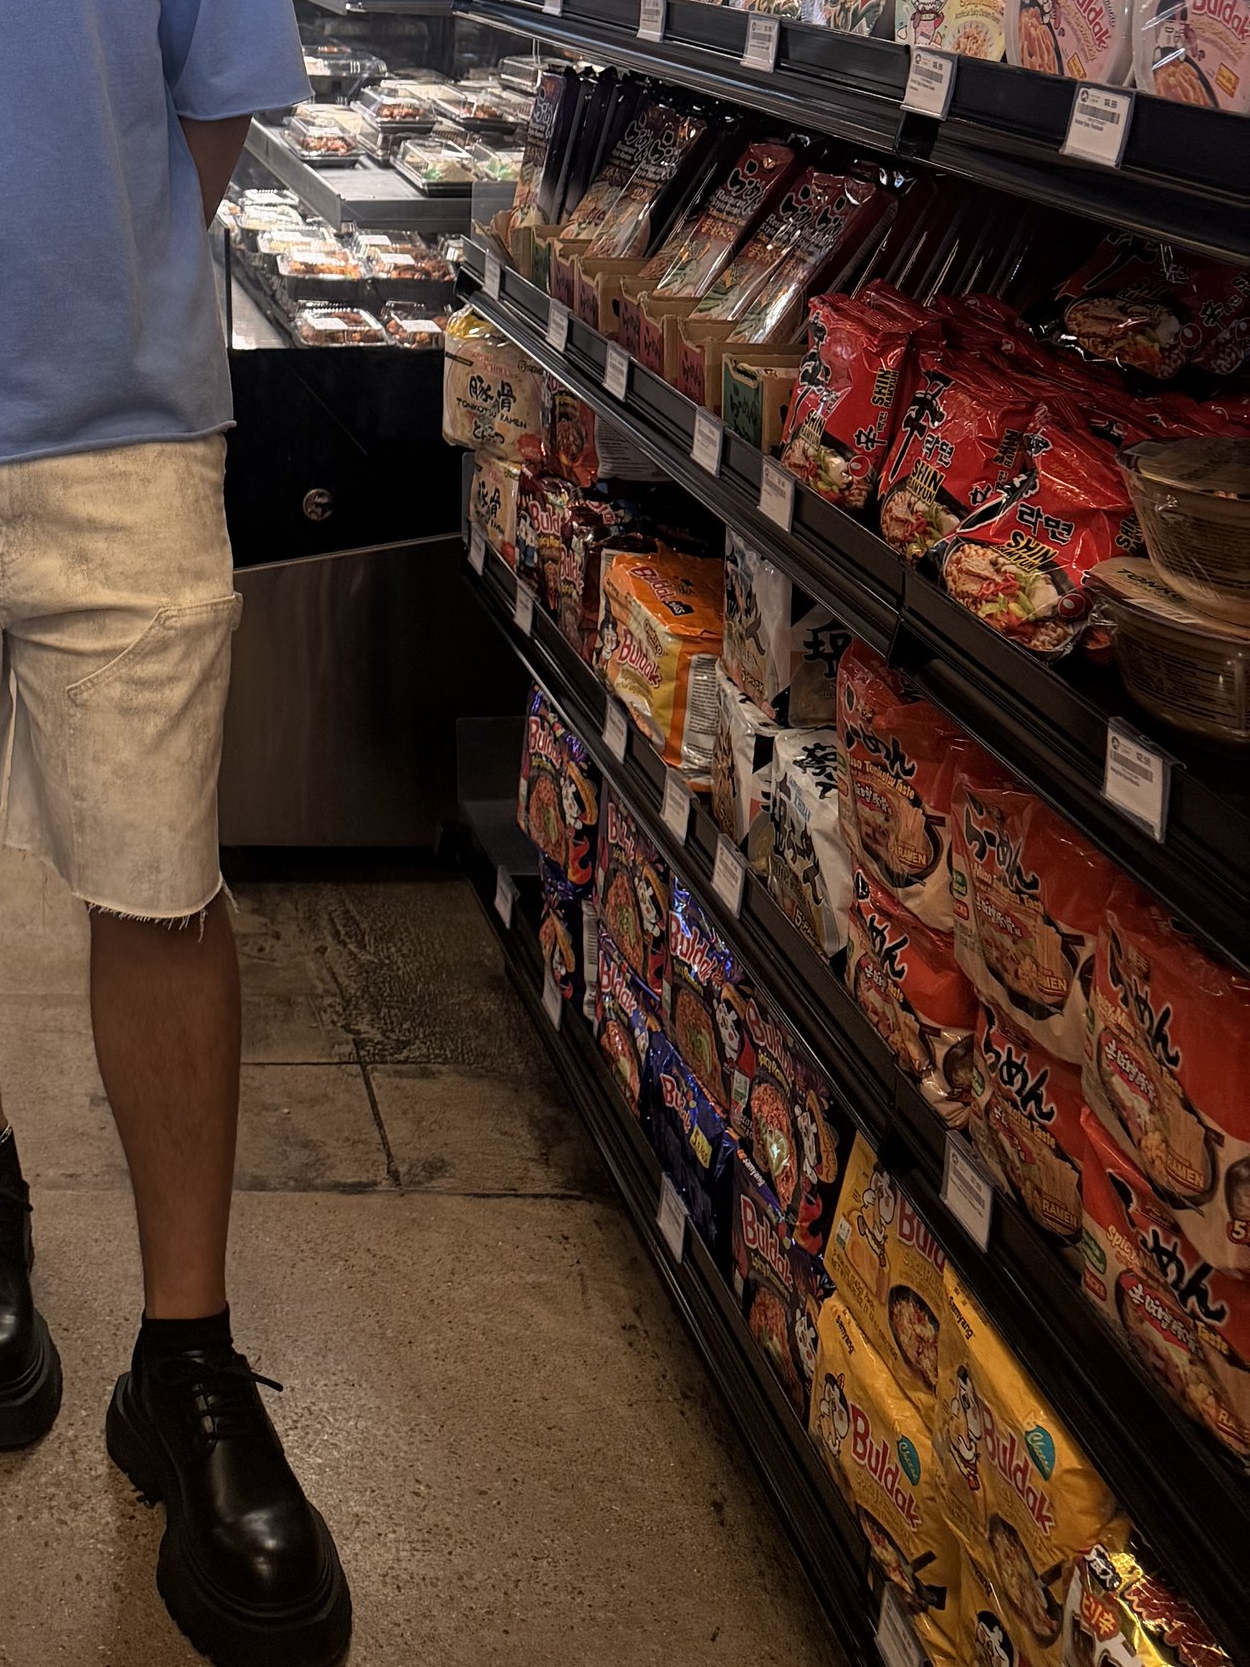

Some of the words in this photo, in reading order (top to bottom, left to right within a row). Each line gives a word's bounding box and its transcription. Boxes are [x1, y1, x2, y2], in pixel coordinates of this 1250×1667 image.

[468, 374, 517, 413] 豚骨
[871, 368, 892, 406] SHIN
[884, 369, 899, 408] RAMYUN
[993, 430, 1023, 465] SHIN
[911, 458, 947, 493] SHIN
[1016, 501, 1076, 546] 라면
[1005, 529, 1060, 563] SHIN
[616, 627, 662, 689] Buldak
[897, 780, 916, 801] Taste
[668, 909, 718, 985] Buldak
[745, 996, 796, 1083] Buldak
[1041, 1200, 1078, 1228] RAMEN
[740, 1194, 794, 1293] Buldak
[849, 1401, 922, 1532] Buldak
[981, 1400, 1055, 1536] Buldak
